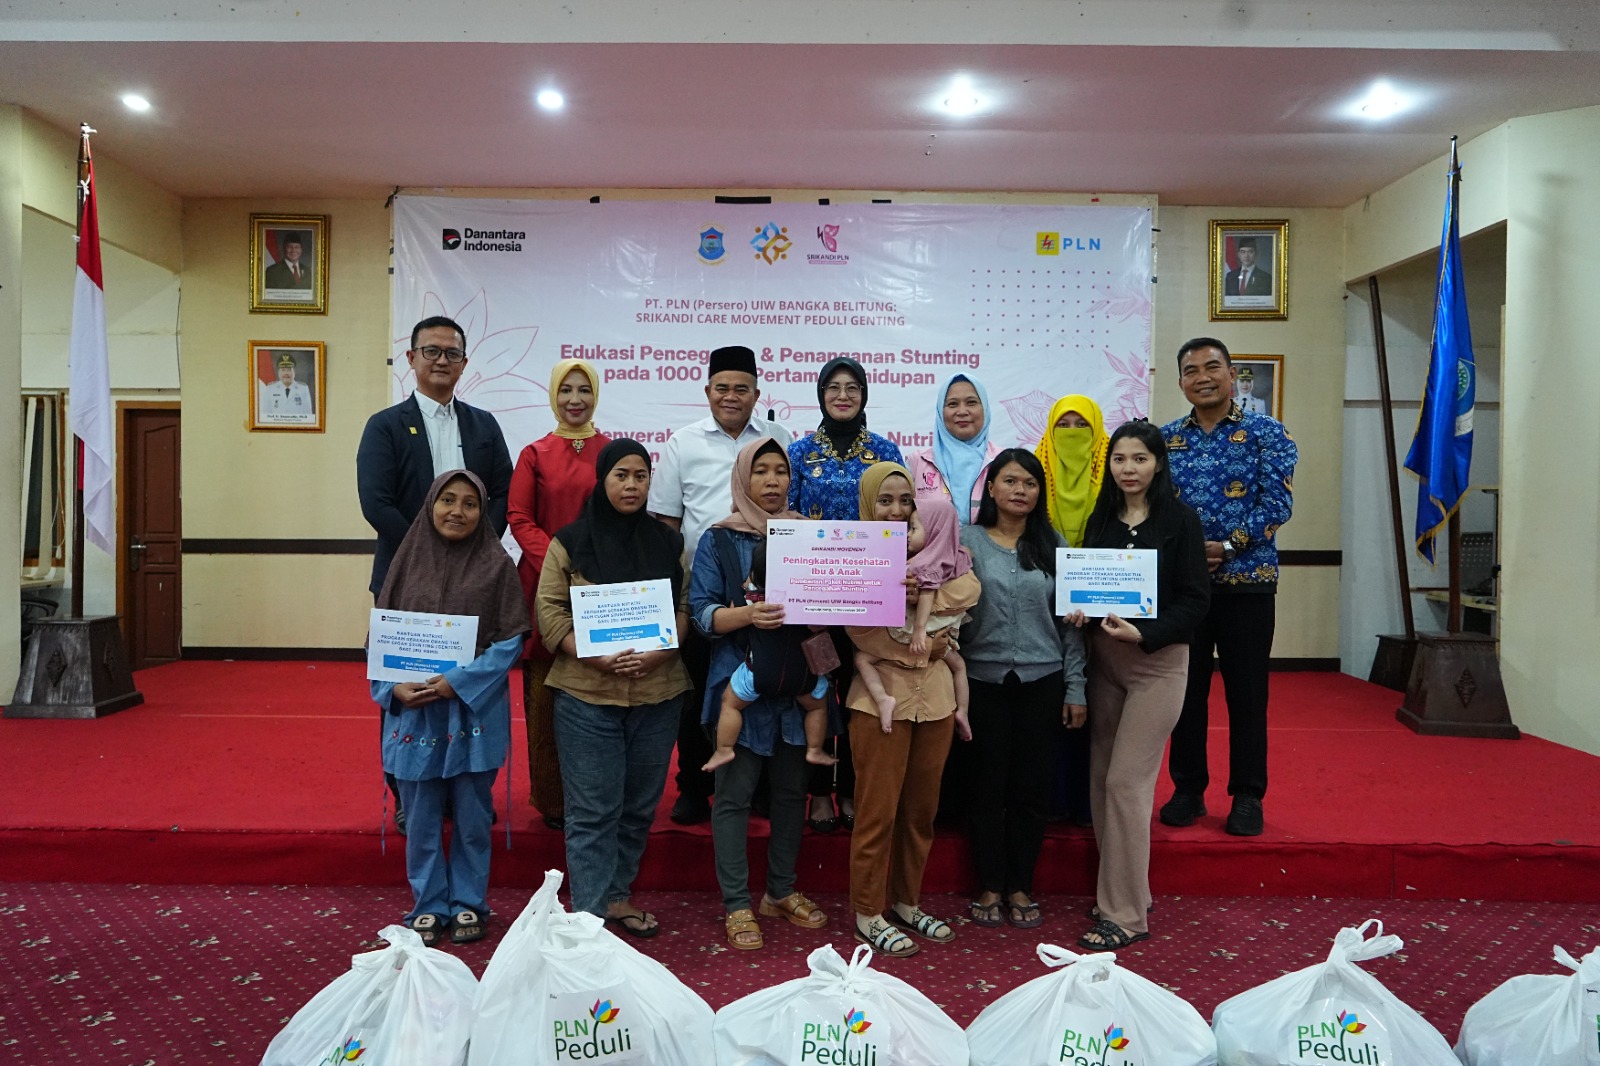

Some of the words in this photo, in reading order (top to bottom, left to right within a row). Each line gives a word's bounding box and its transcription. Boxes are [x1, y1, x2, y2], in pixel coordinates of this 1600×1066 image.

[465, 228, 526, 240] Danantara
[464, 240, 522, 252] Indonesia
[1063, 238, 1100, 250] PLN
[645, 298, 662, 308] PT.
[666, 299, 690, 309] PLN
[694, 300, 748, 311] (Persero)
[752, 300, 776, 310] UIW
[780, 301, 830, 310] BANGKA
[834, 302, 897, 312] BELITUNG:
[636, 313, 693, 323] SRIKANDI
[697, 314, 727, 324] CARE
[731, 314, 800, 324] MOVEMENT
[804, 316, 846, 325] PEDULI
[850, 316, 905, 326] GENTING
[560, 344, 634, 360] Edukasi
[640, 346, 710, 365] Penceg
[760, 347, 774, 362] &
[900, 349, 980, 369] Stunting
[604, 366, 650, 384] pada
[656, 366, 702, 381] 1000
[756, 368, 819, 382] Pertam
[888, 432, 934, 446] Nutri
[783, 556, 840, 566] Peningkatan
[842, 558, 890, 566] Kesehatan
[554, 1019, 588, 1038] PLN
[804, 1023, 840, 1042] PLN
[1298, 1022, 1336, 1039] PLN
[555, 1021, 631, 1060] Peduli
[802, 1031, 876, 1066] Peduli
[1064, 1029, 1102, 1056] PLN
[1298, 1032, 1379, 1066] Peduli
